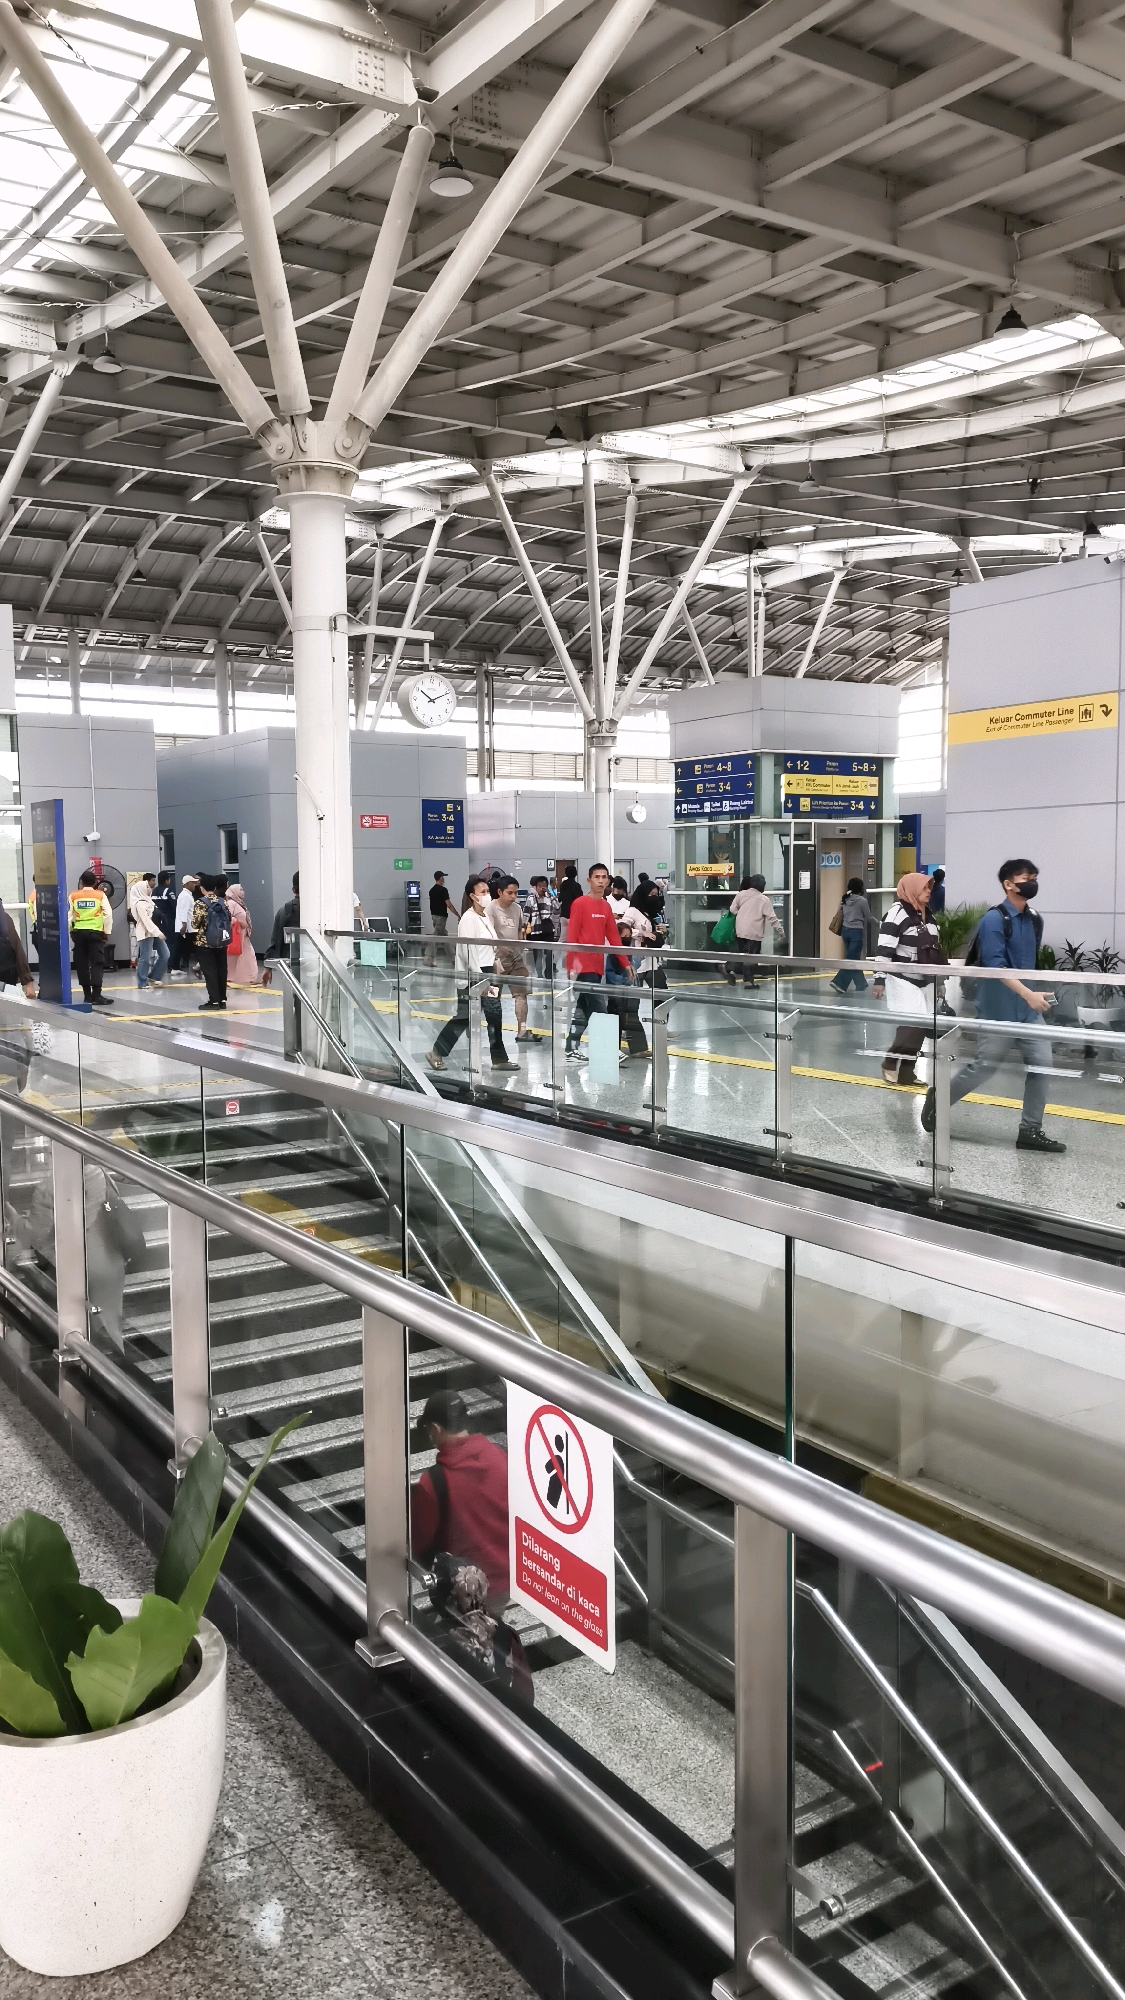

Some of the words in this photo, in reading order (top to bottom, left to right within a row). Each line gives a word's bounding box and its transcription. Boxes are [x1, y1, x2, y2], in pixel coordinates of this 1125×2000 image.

[989, 716, 1013, 725] Keluar
[1014, 710, 1056, 722] Commuter
[1057, 707, 1075, 716] Line
[522, 1531, 561, 1572] Dilarang
[522, 1552, 565, 1593] bersandar
[566, 1585, 576, 1601] di
[578, 1590, 600, 1618] kaca
[522, 1571, 532, 1585] Do
[532, 1580, 544, 1594] not
[544, 1587, 560, 1606] lean
[561, 1602, 570, 1614] on
[572, 1608, 583, 1622] the
[584, 1618, 603, 1638] glass
